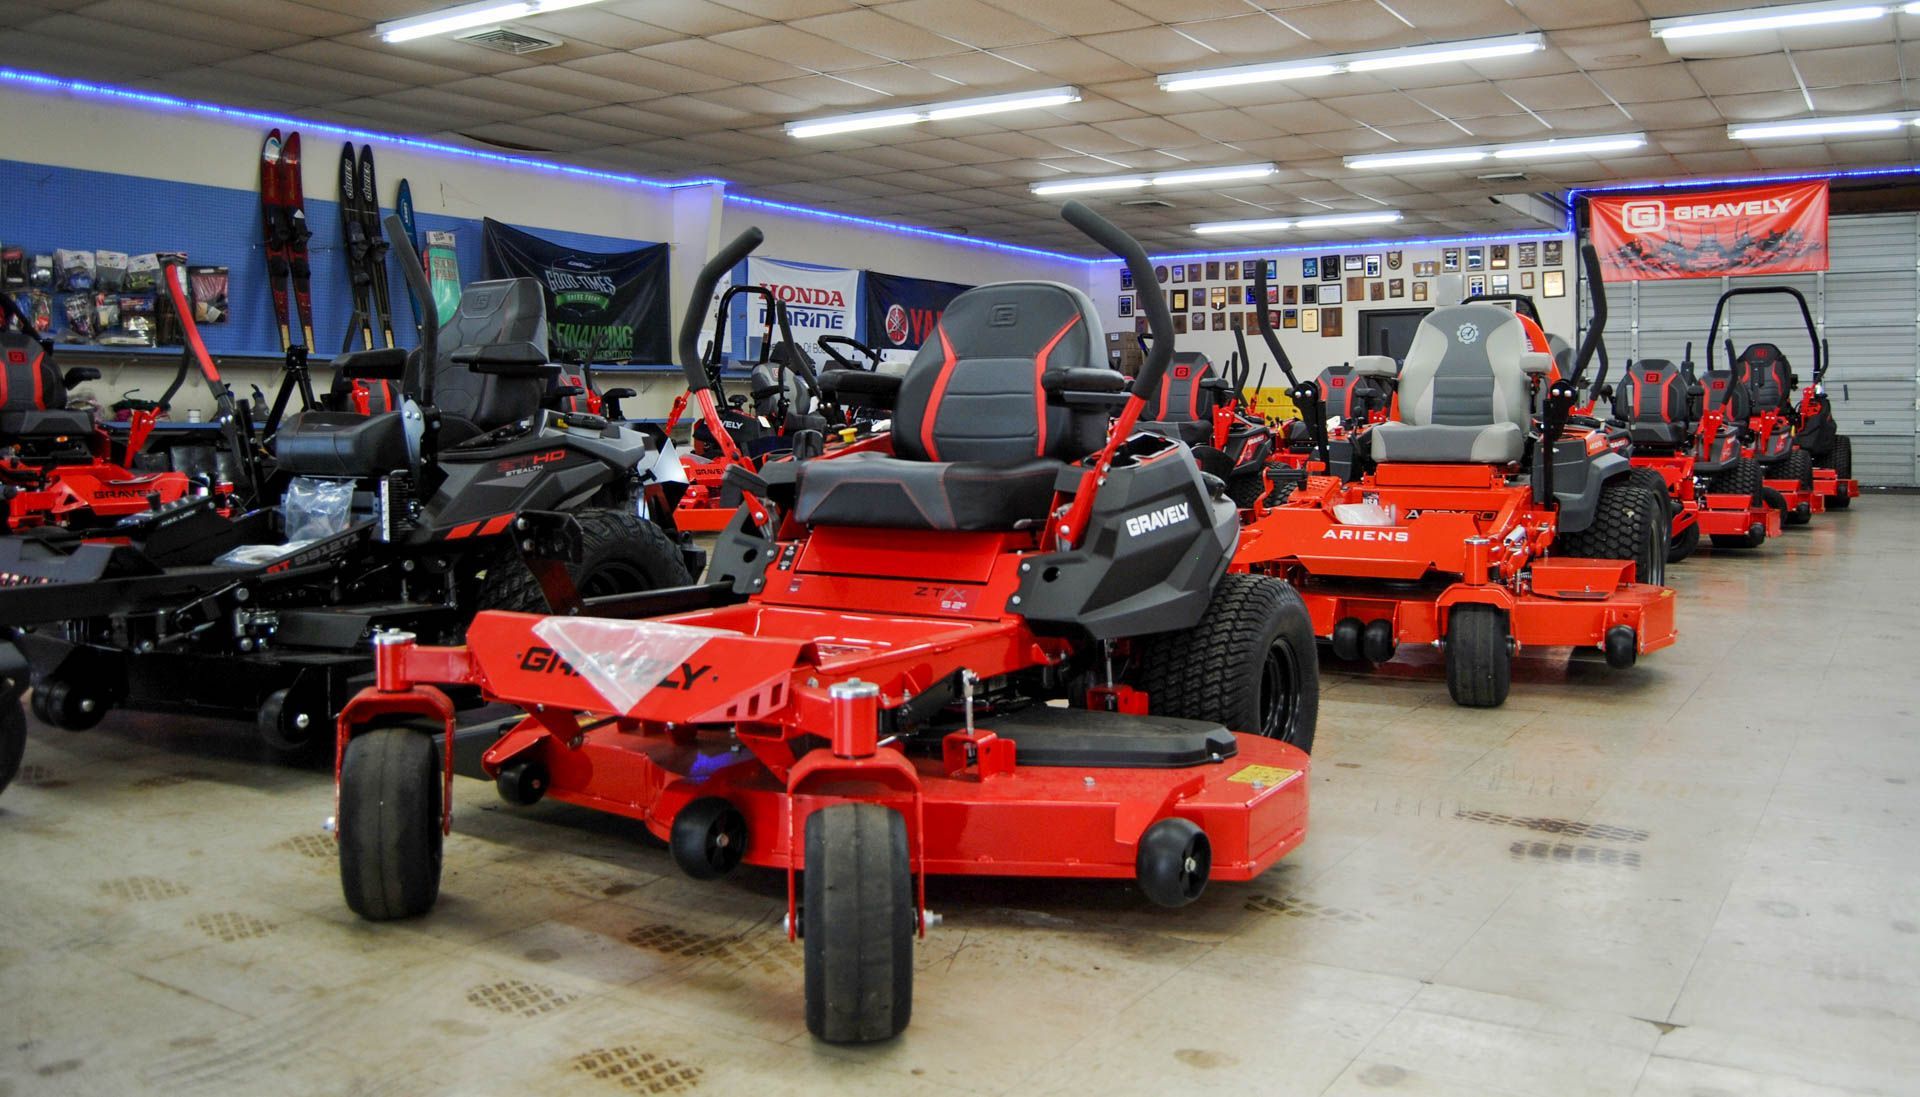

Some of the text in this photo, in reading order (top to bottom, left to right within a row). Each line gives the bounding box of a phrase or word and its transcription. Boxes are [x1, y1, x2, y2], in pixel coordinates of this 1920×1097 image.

[1673, 198, 1793, 220] GRAVELY
[758, 283, 845, 308] HONDA
[556, 322, 634, 349] FINANCING
[505, 464, 544, 477] STEALTH
[1126, 502, 1189, 537] GRAVELY
[1322, 529, 1409, 541] ARIENS
[519, 646, 712, 690] GRLY
